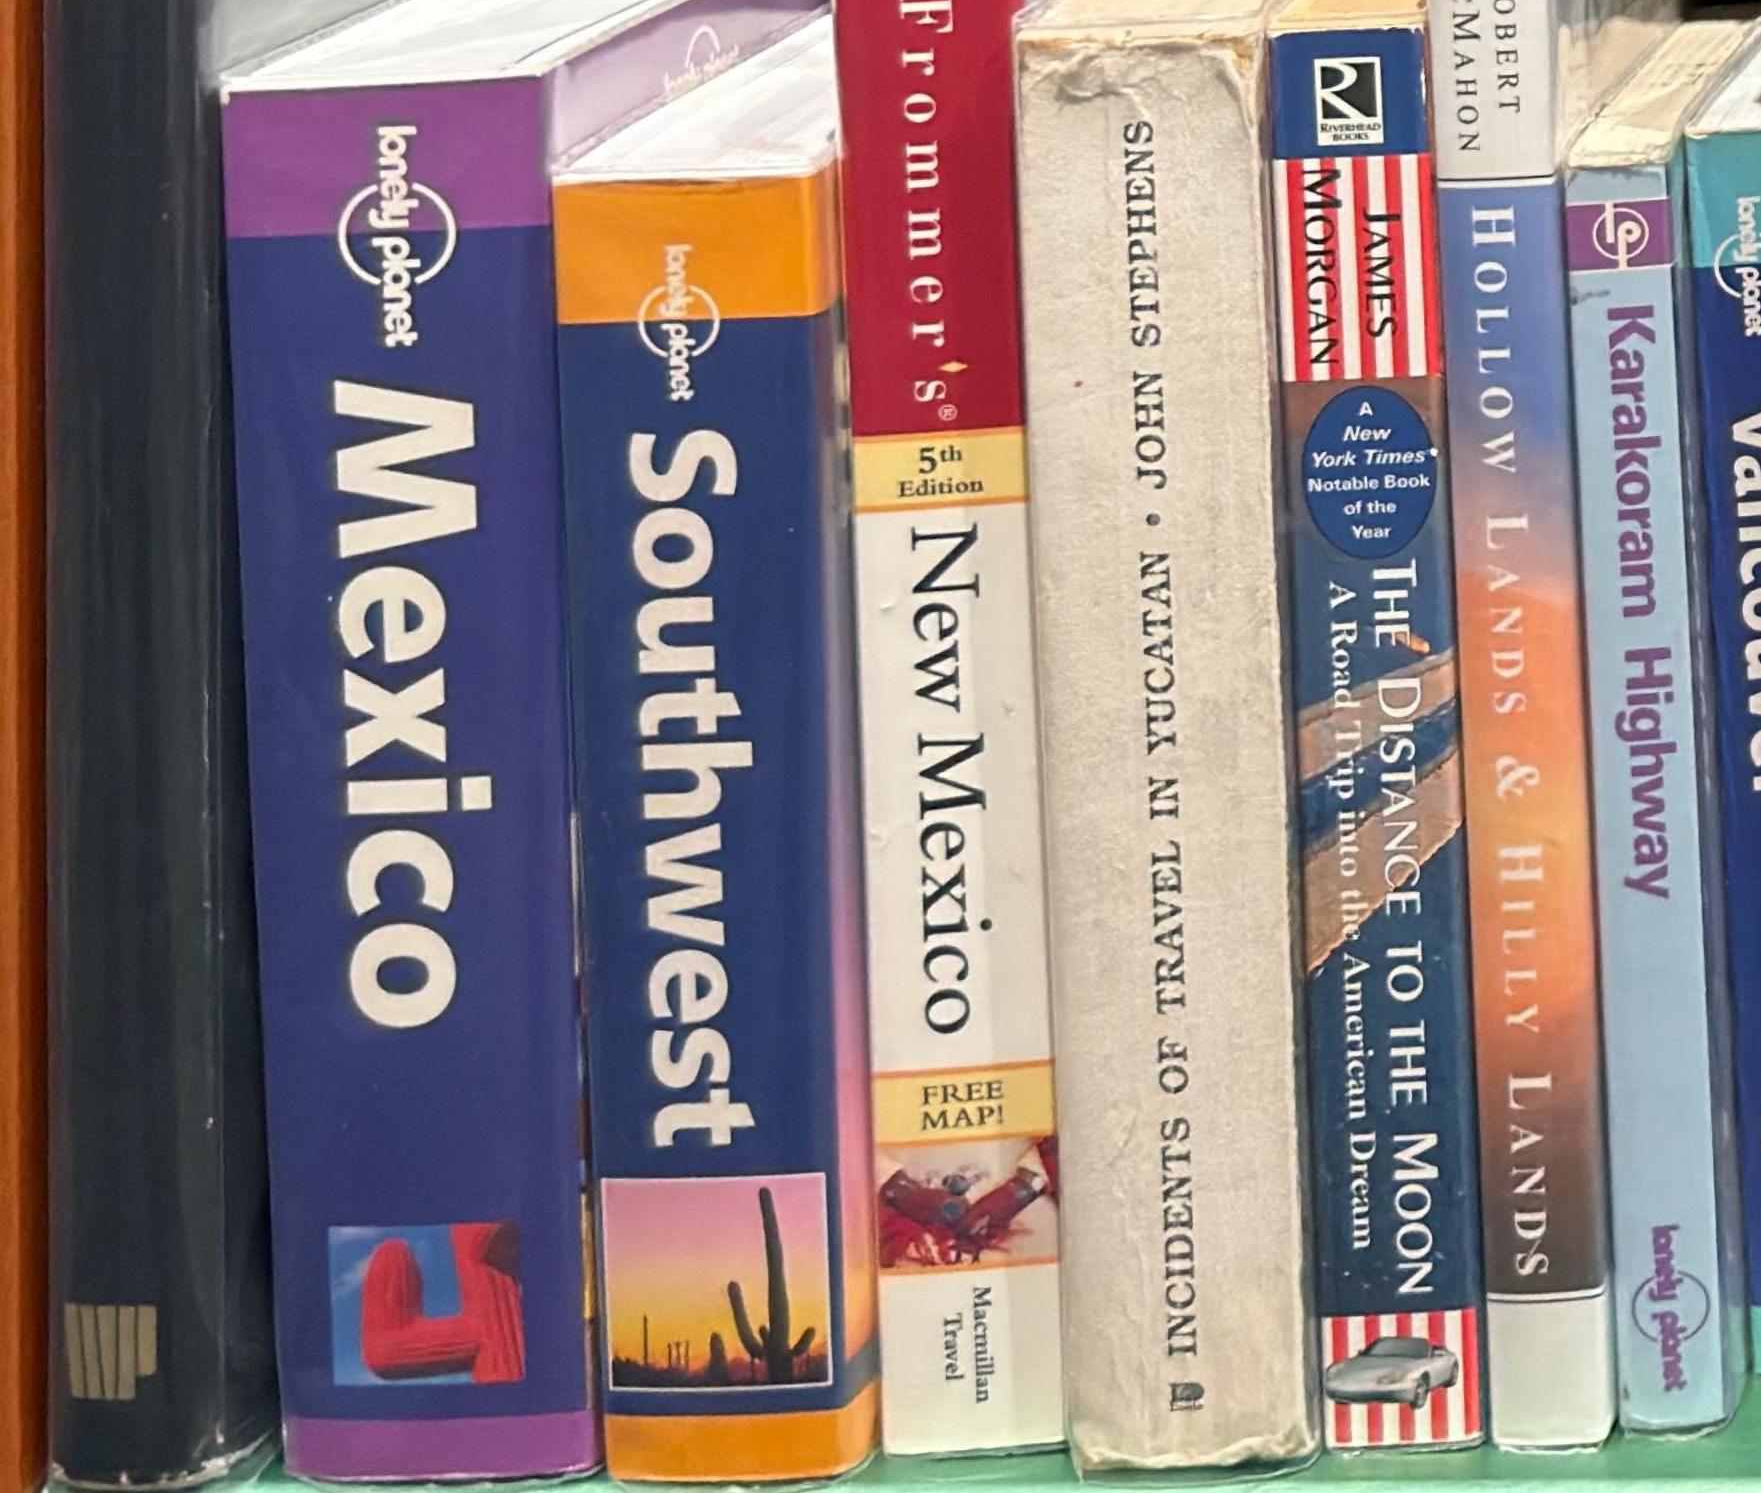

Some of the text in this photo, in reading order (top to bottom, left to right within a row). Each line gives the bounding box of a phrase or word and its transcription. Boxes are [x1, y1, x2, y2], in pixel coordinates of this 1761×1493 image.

[1318, 121, 1382, 134] RIVERHEAD
[369, 126, 420, 346] lonely planet
[1300, 168, 1342, 366] MORGAN
[1363, 211, 1399, 339] JAMES
[898, 476, 984, 500] Edition
[919, 444, 963, 472] 5th
[1307, 472, 1430, 493] Notable Book
[1353, 523, 1392, 541] Year
[1606, 304, 1674, 900] Karakoram Highway
[333, 379, 491, 1028] Mexico
[910, 524, 993, 1037] New Mexico
[1123, 120, 1198, 1357] INCIDENTS TRAVEL YUCATAN JOHN STEPHENS
[1472, 206, 1552, 1281] HOLLOW LANDS HILLY LANDS
[628, 429, 755, 1148] Southwest
[1330, 620, 1376, 1250] Road Trip American Dream
[1369, 559, 1434, 1295] THE DISTANCE MOON
[921, 1080, 1004, 1106] FREE
[921, 1105, 1004, 1130] MAP!
[942, 1313, 961, 1381] Travel
[972, 1287, 995, 1403] Macmillan
